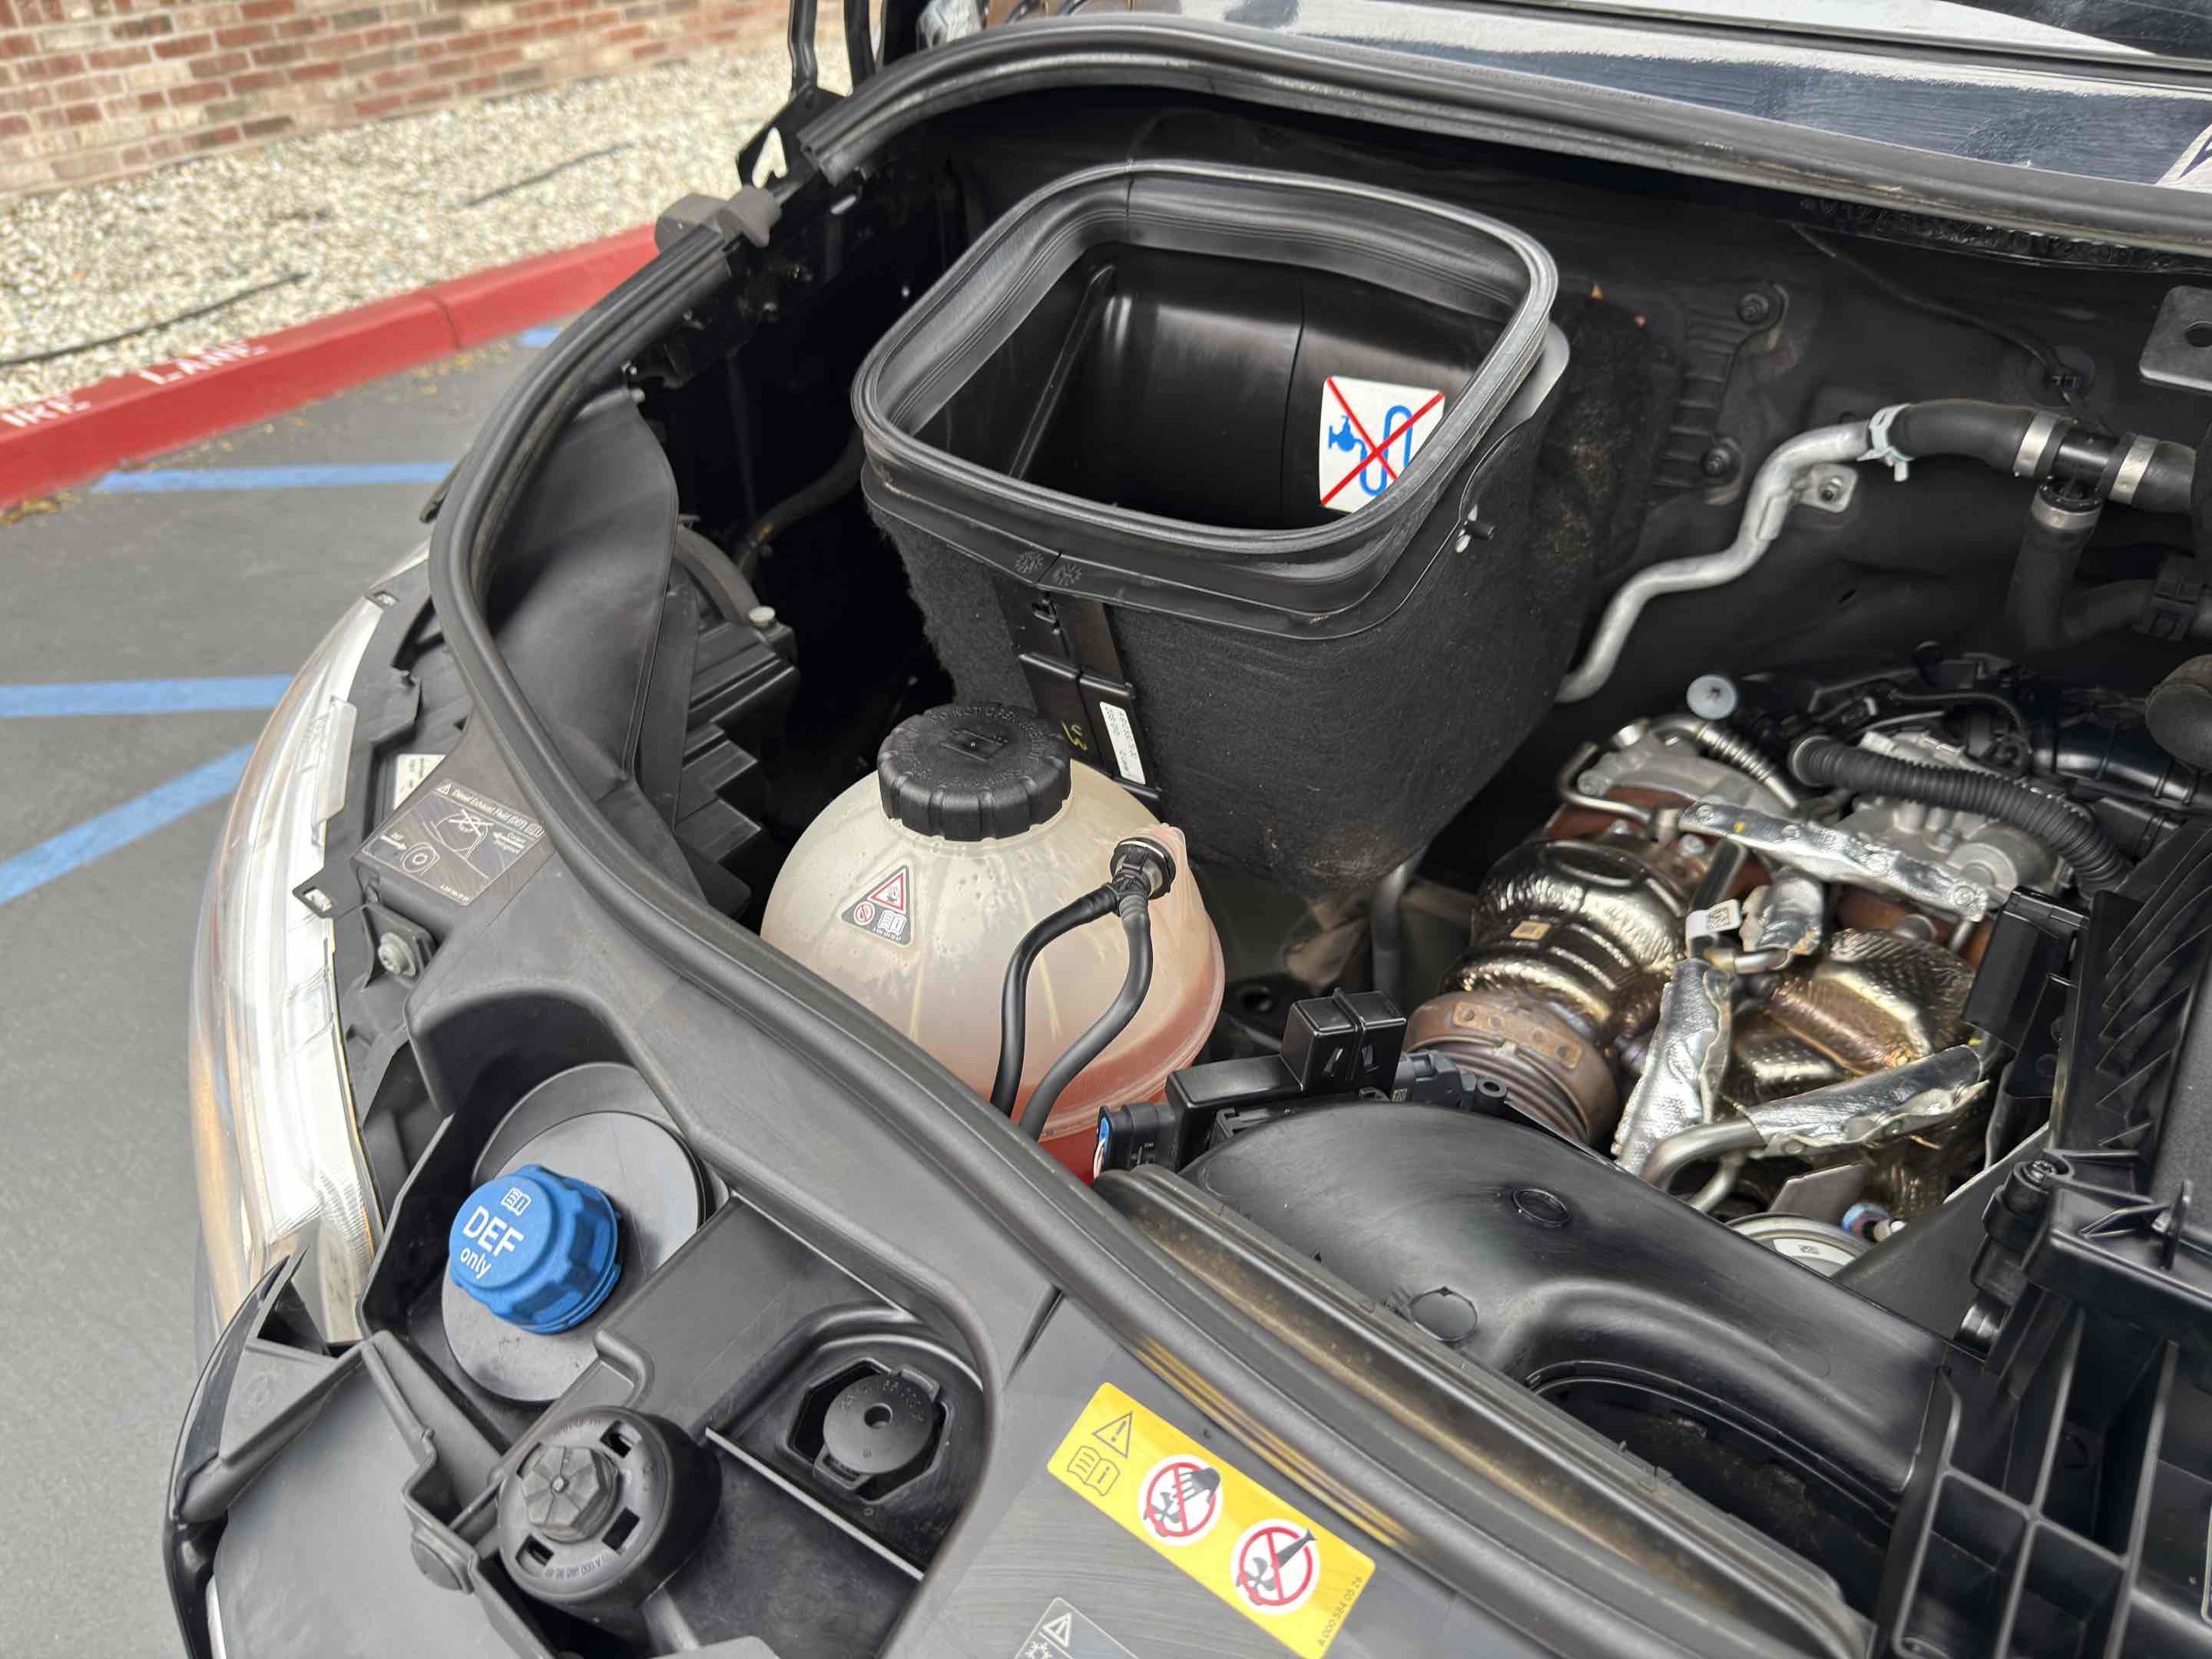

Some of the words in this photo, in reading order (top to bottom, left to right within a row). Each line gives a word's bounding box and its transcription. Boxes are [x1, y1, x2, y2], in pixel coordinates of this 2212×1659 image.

[137, 341, 269, 386] LANE
[462, 1205, 525, 1257] DEF
[461, 1247, 492, 1280] only
